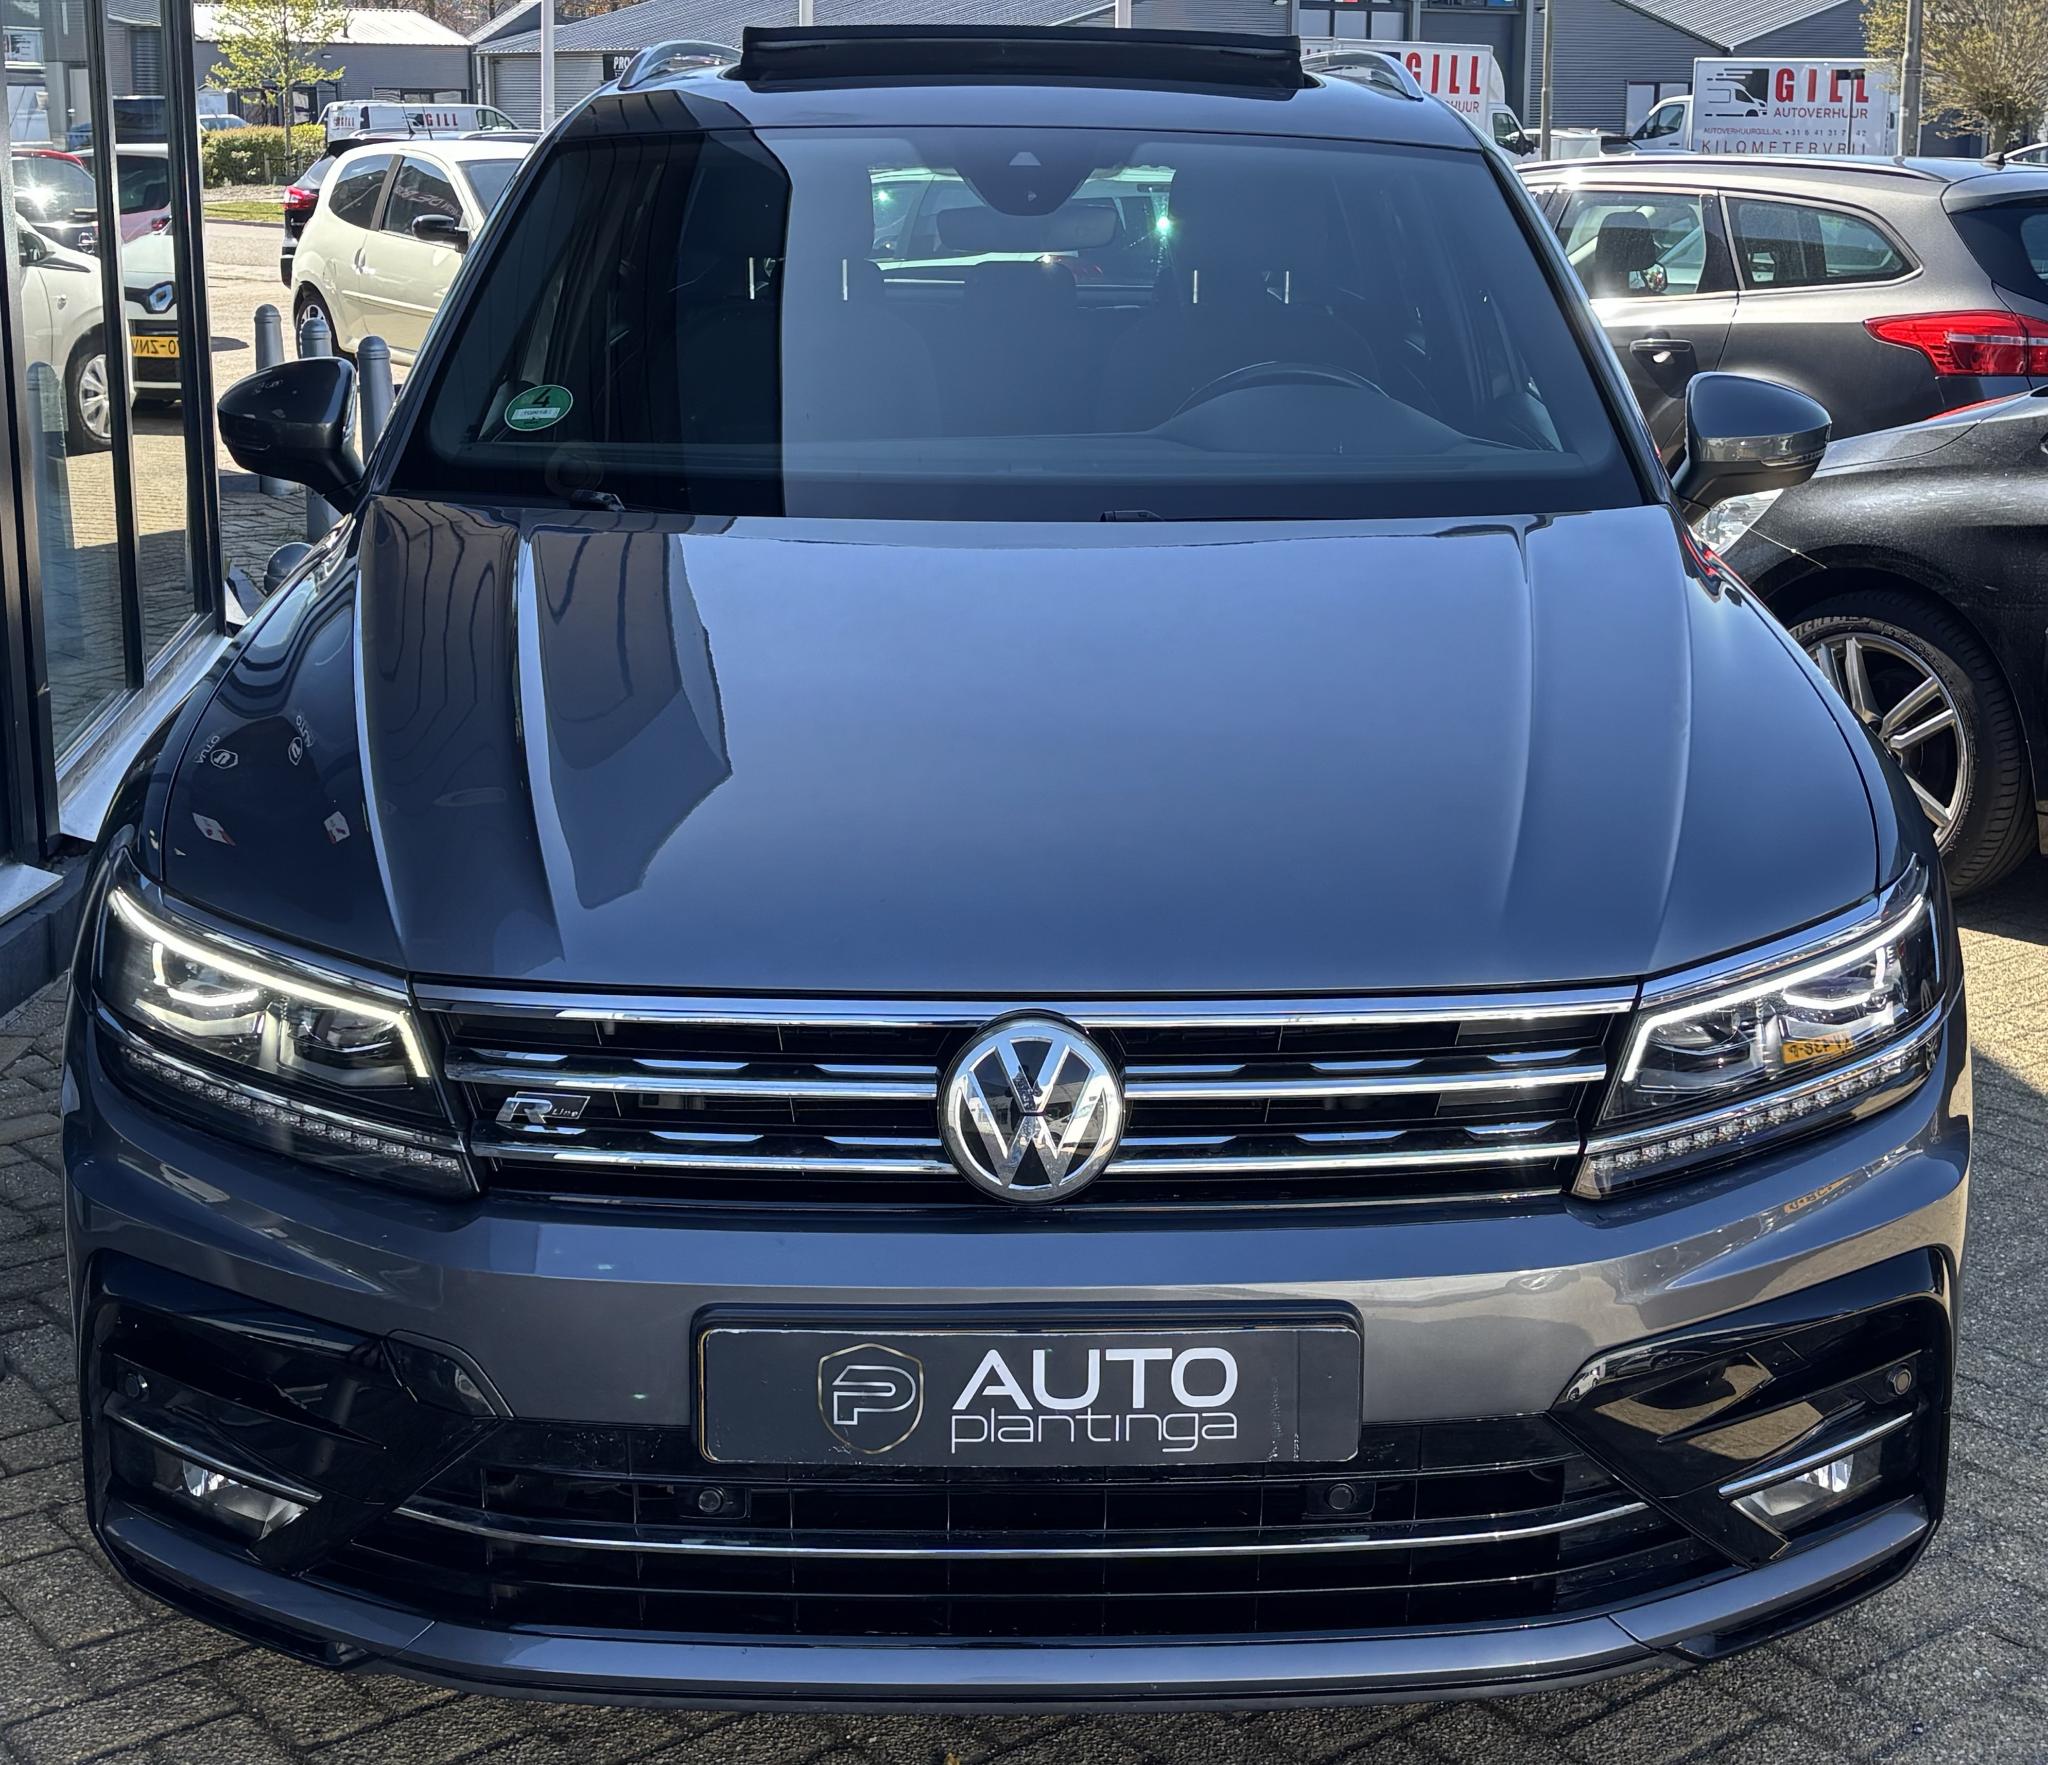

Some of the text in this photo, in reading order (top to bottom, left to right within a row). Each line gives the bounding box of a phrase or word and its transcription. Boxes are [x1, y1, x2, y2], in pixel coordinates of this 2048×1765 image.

[1405, 52, 1481, 95] GILL
[1775, 68, 1869, 103] GILL
[425, 113, 458, 129] GILL
[1773, 106, 1868, 119] AUTOVERHUUR
[532, 388, 552, 408] 4
[952, 1347, 1238, 1410] AUTO
[951, 1407, 1238, 1454] plantinga
